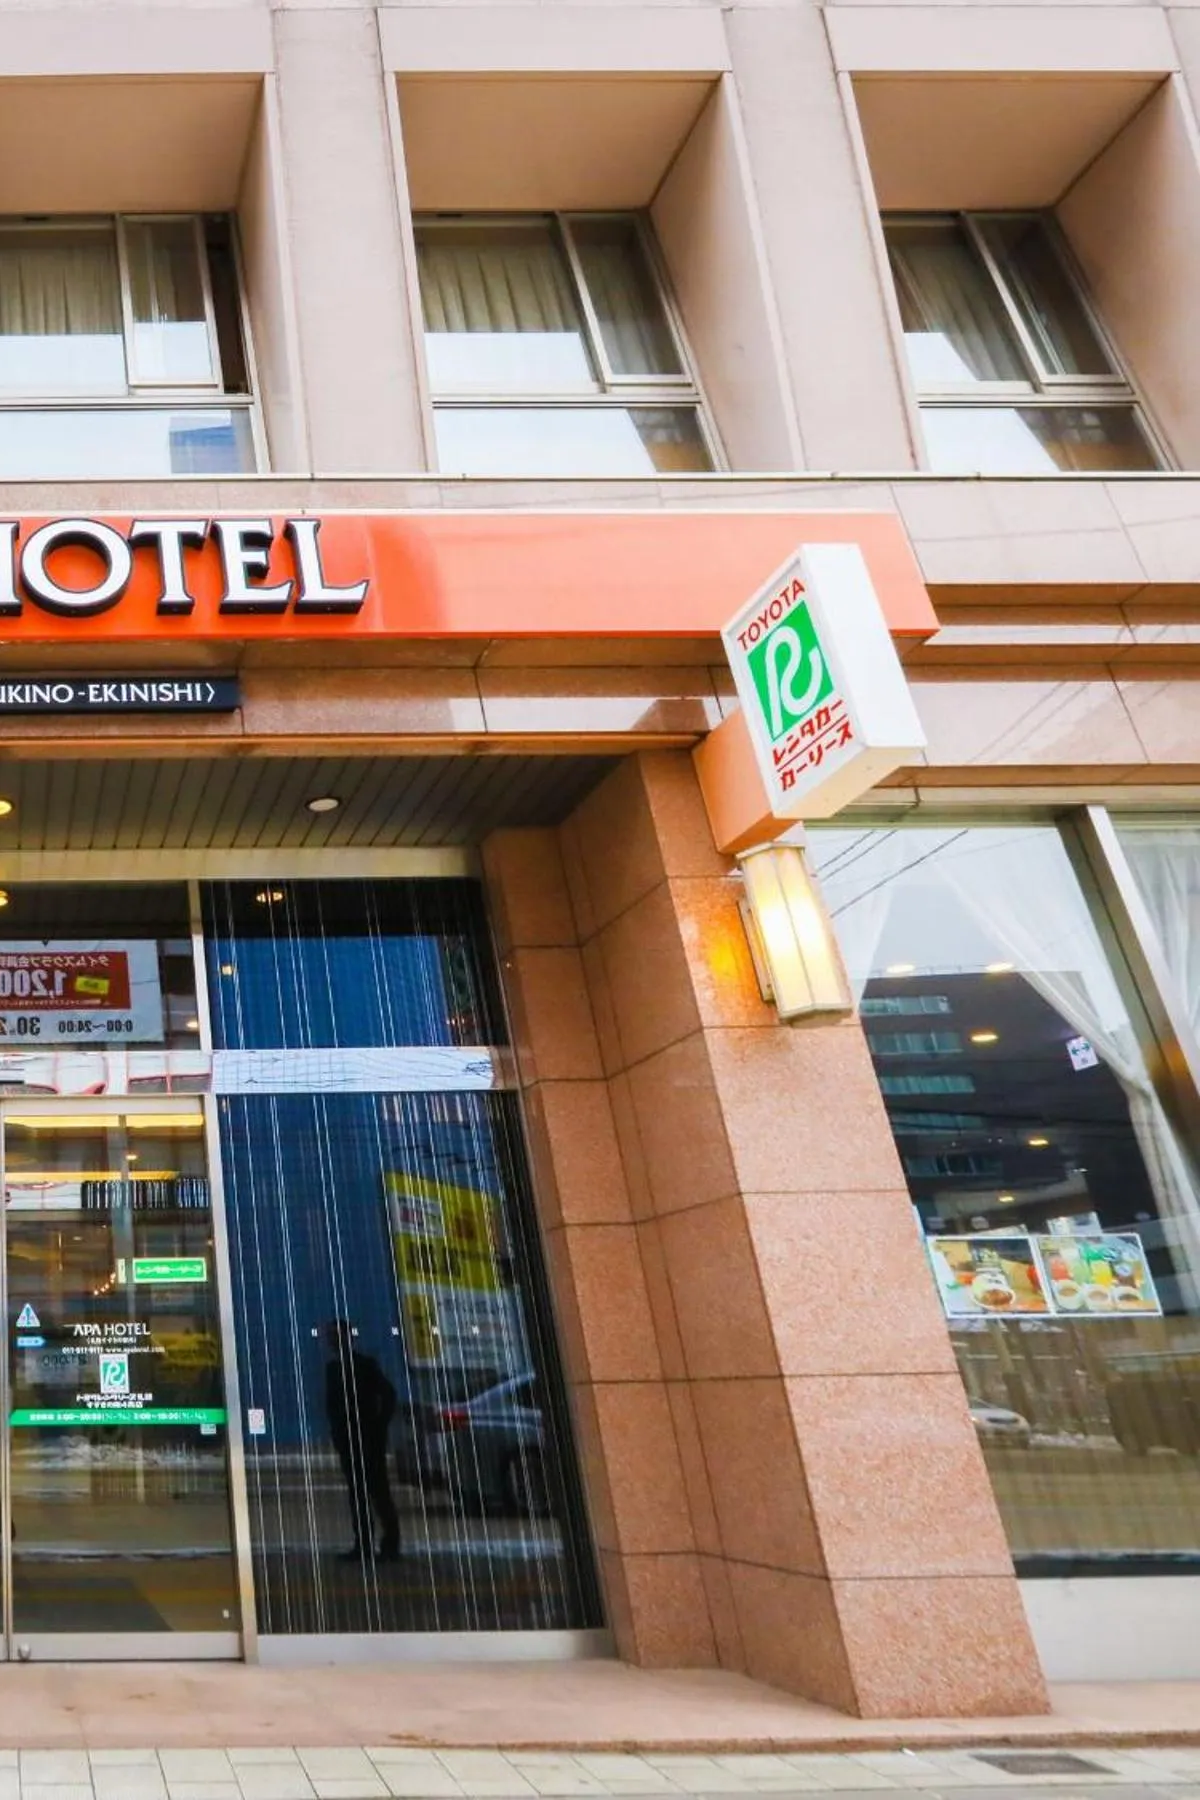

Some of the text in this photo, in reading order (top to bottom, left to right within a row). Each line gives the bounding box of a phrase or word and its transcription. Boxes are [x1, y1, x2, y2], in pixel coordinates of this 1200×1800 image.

[737, 578, 805, 651] TOYOTA
[772, 700, 843, 766] レンタカー
[780, 721, 853, 792] カーリース
[73, 1323, 152, 1336] APA HOTEL
